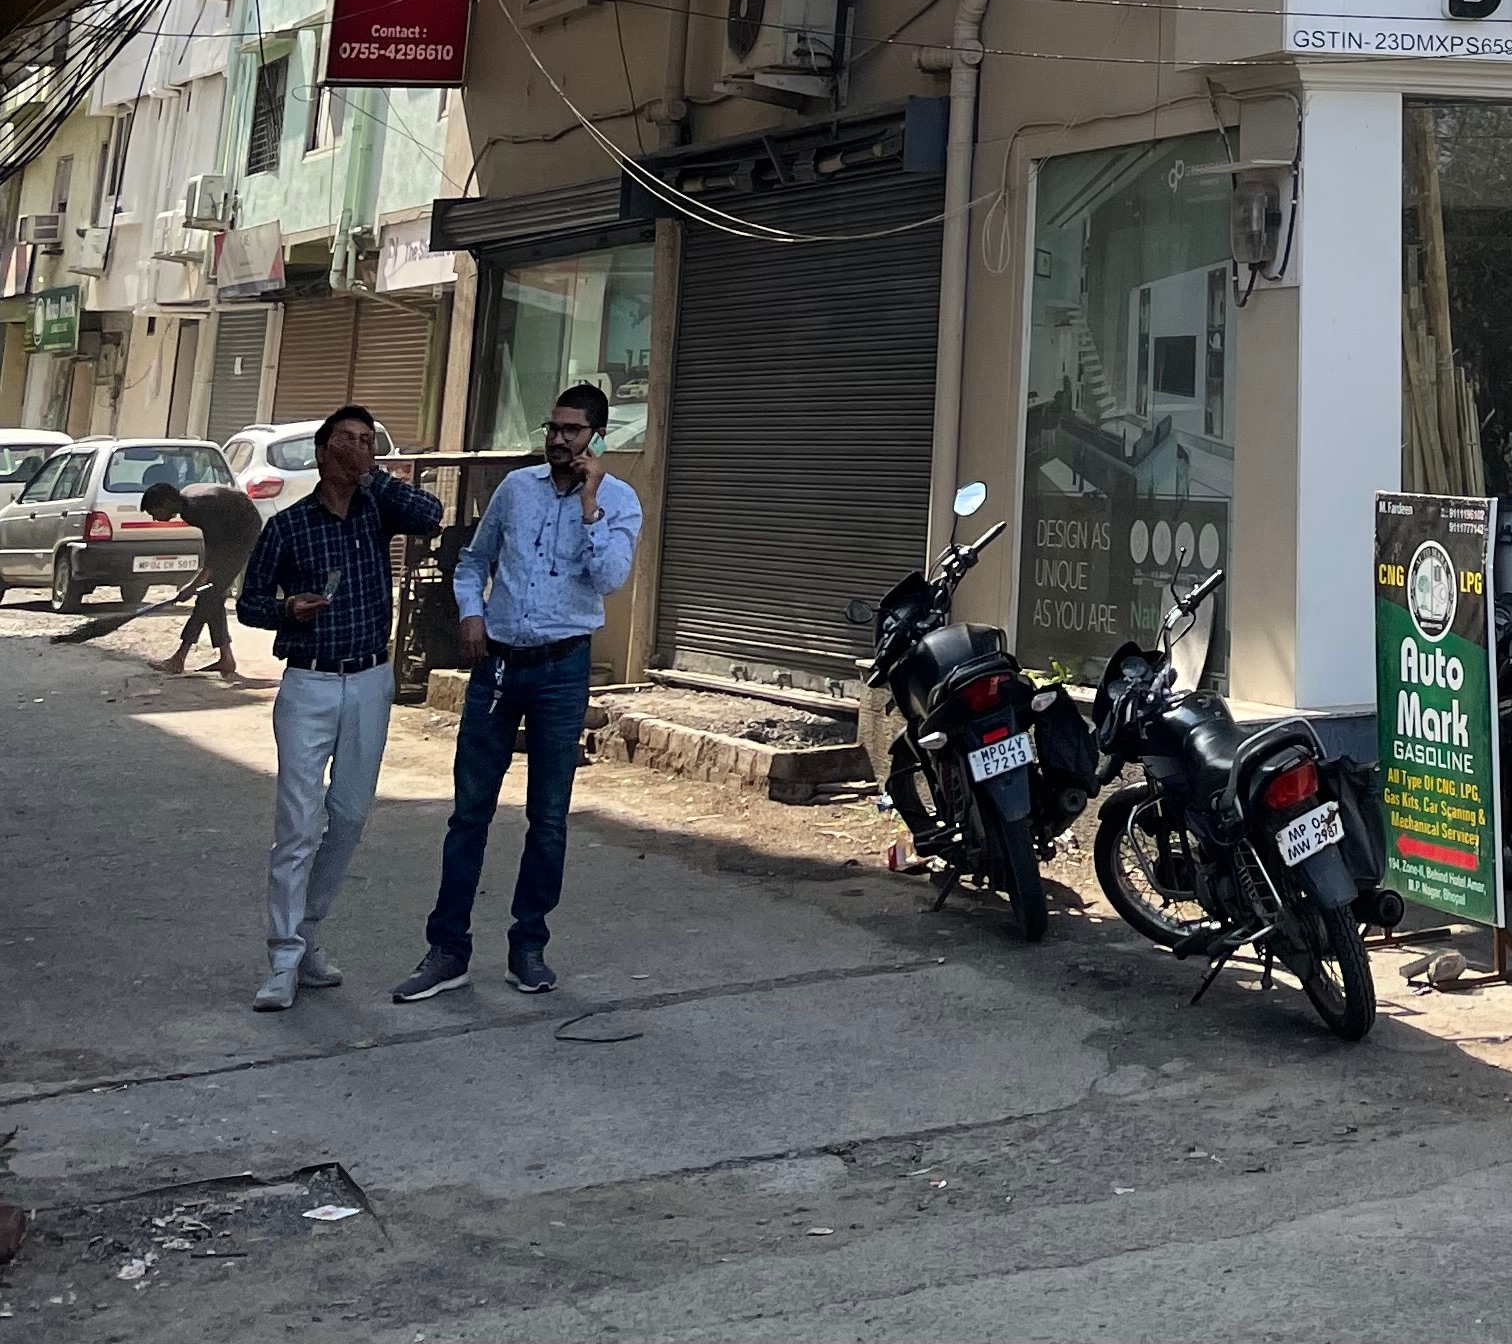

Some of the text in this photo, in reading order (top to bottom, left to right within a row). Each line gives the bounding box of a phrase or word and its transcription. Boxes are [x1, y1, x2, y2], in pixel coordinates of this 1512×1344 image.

[339, 42, 454, 61] 0755-4296610
[1036, 518, 1111, 551] DESIGN AS
[1034, 558, 1088, 593] UNIQUE
[1379, 563, 1483, 595] CNG LPG
[1033, 598, 1118, 635] AS YOU ARE
[1400, 636, 1464, 691] Auto
[1397, 689, 1469, 748] Mark
[984, 750, 1027, 776] E7213
[1393, 740, 1474, 774] GASOLINE
[1387, 767, 1399, 784] All
[1402, 769, 1422, 790] Type
[1384, 788, 1400, 806] Gas
[1423, 796, 1438, 814] Car
[1478, 809, 1486, 826] &
[1287, 822, 1338, 861] MW 2987
[1288, 823, 1306, 843] MP
[1391, 810, 1480, 848] Mechanical Services
